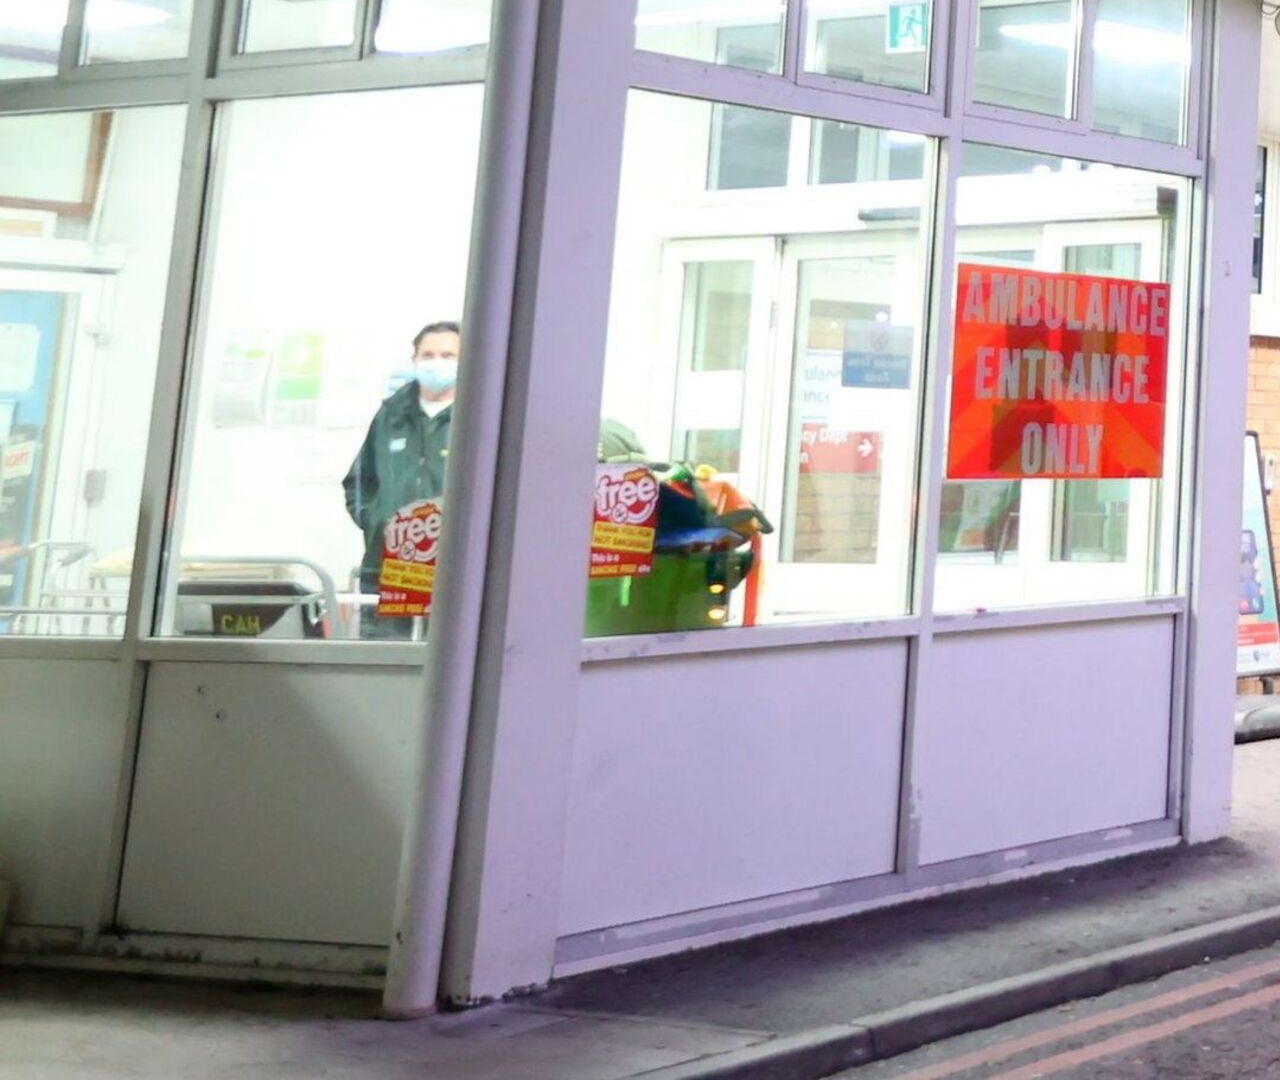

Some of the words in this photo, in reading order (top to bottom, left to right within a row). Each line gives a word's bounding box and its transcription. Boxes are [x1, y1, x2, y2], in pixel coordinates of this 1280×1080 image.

[962, 271, 1167, 336] AMBULANCE
[975, 346, 1150, 404] ENTRANCE
[1021, 422, 1103, 475] ONLY
[597, 475, 657, 514] free
[385, 510, 441, 553] free
